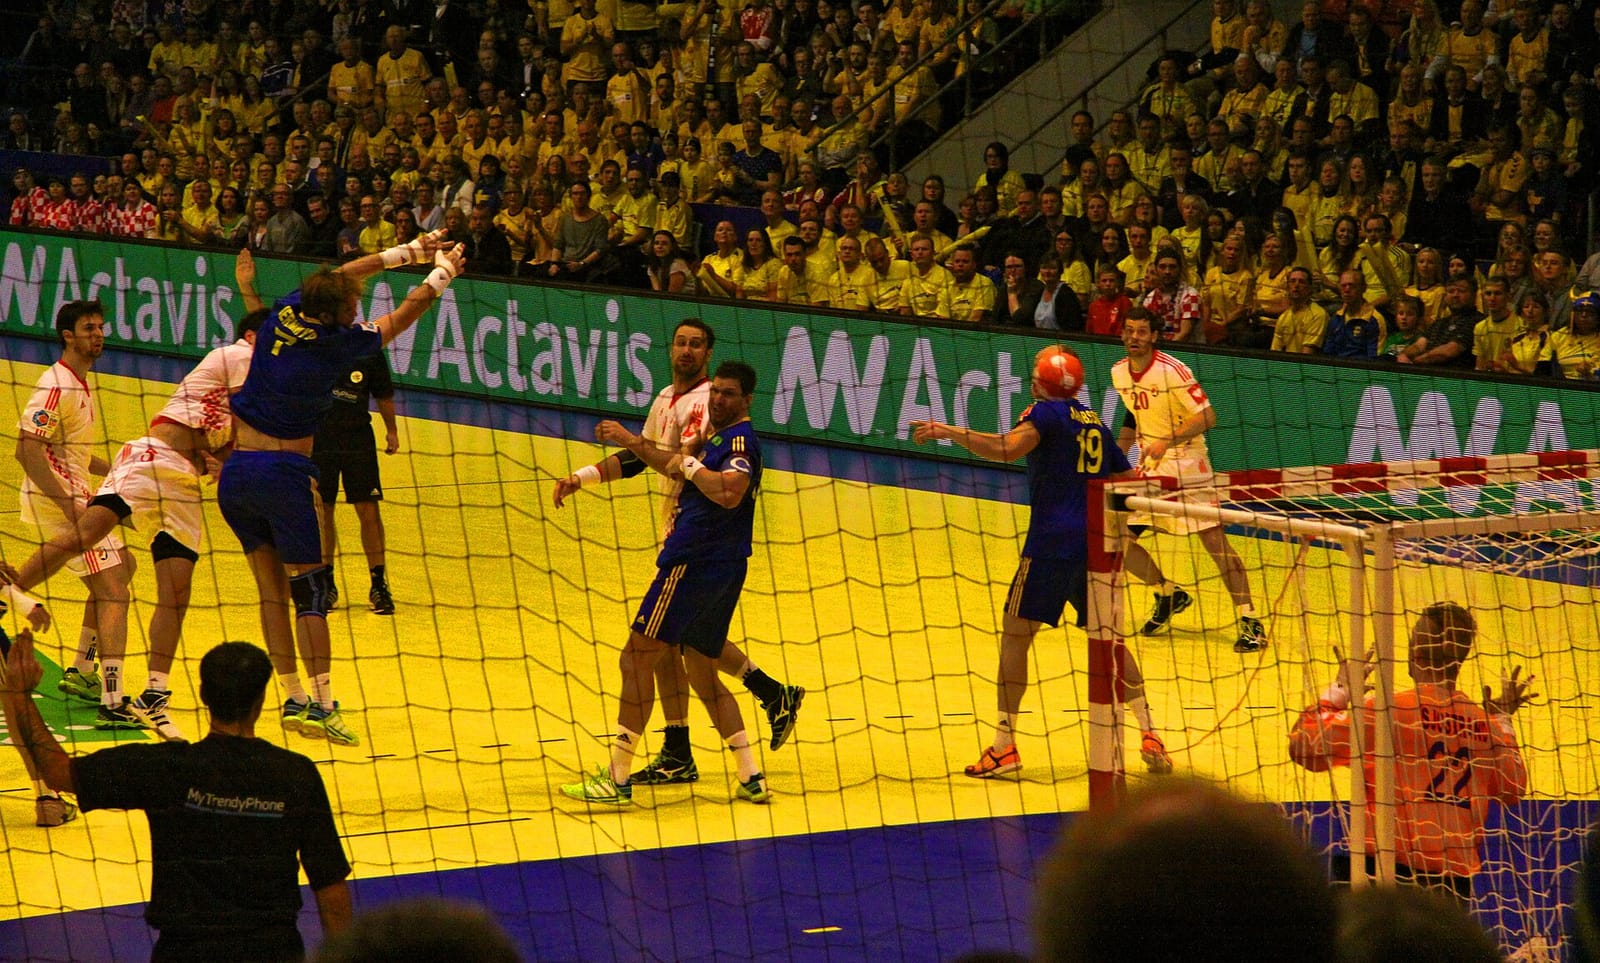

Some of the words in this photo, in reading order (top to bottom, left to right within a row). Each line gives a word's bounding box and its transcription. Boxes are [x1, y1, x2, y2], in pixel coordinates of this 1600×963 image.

[50, 246, 235, 349] Actavis
[427, 287, 653, 407] Actavis
[1130, 391, 1149, 410] 20
[1076, 428, 1103, 474] 19
[187, 788, 285, 813] MyTrendyPhone
[1424, 741, 1472, 810] 22
